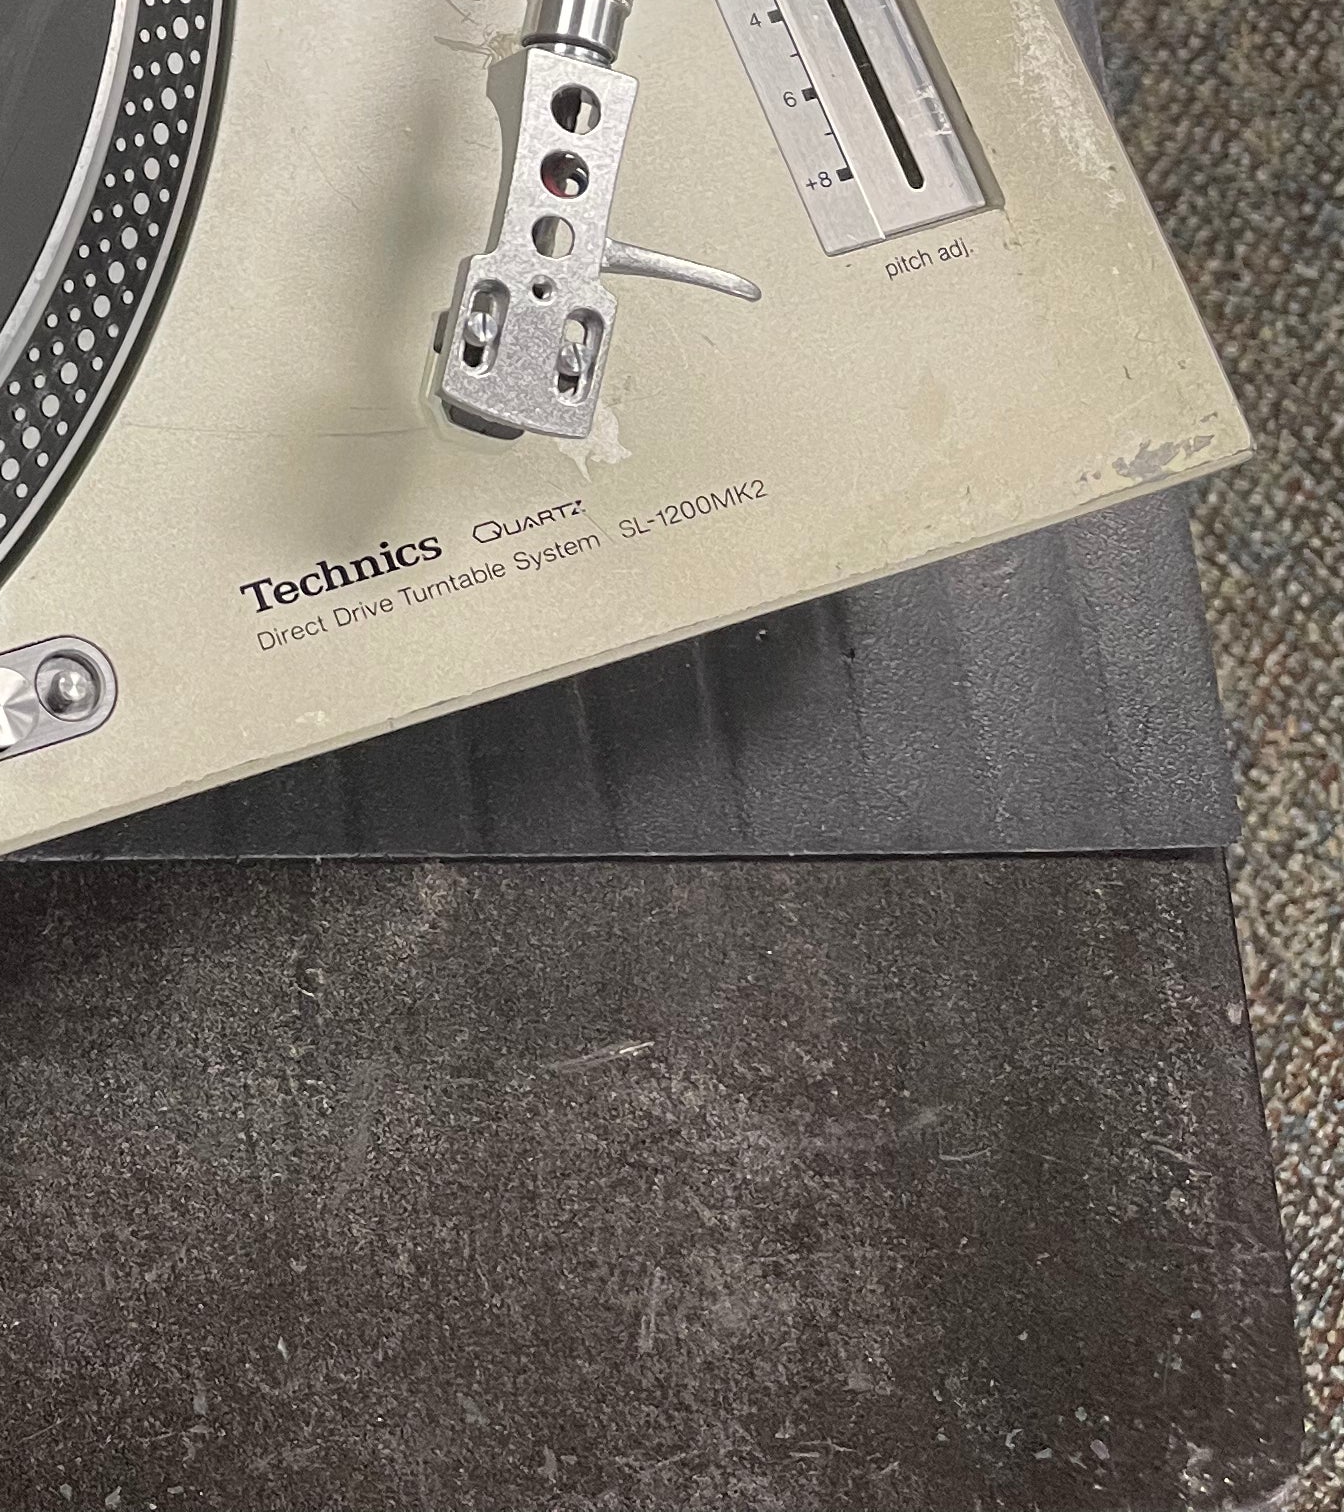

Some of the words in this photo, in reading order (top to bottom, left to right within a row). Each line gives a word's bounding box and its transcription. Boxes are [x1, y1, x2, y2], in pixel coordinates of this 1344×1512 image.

[749, 12, 762, 28] 4
[782, 90, 797, 107] 6
[805, 171, 833, 191] +8
[884, 249, 934, 281] pitch
[937, 237, 974, 262] adj.
[239, 536, 443, 614] Technics
[256, 615, 329, 652] Direct
[332, 597, 394, 628] Drive
[397, 562, 507, 606] Turntable
[512, 533, 602, 572] System
[618, 479, 769, 539] SL-1200MK2
